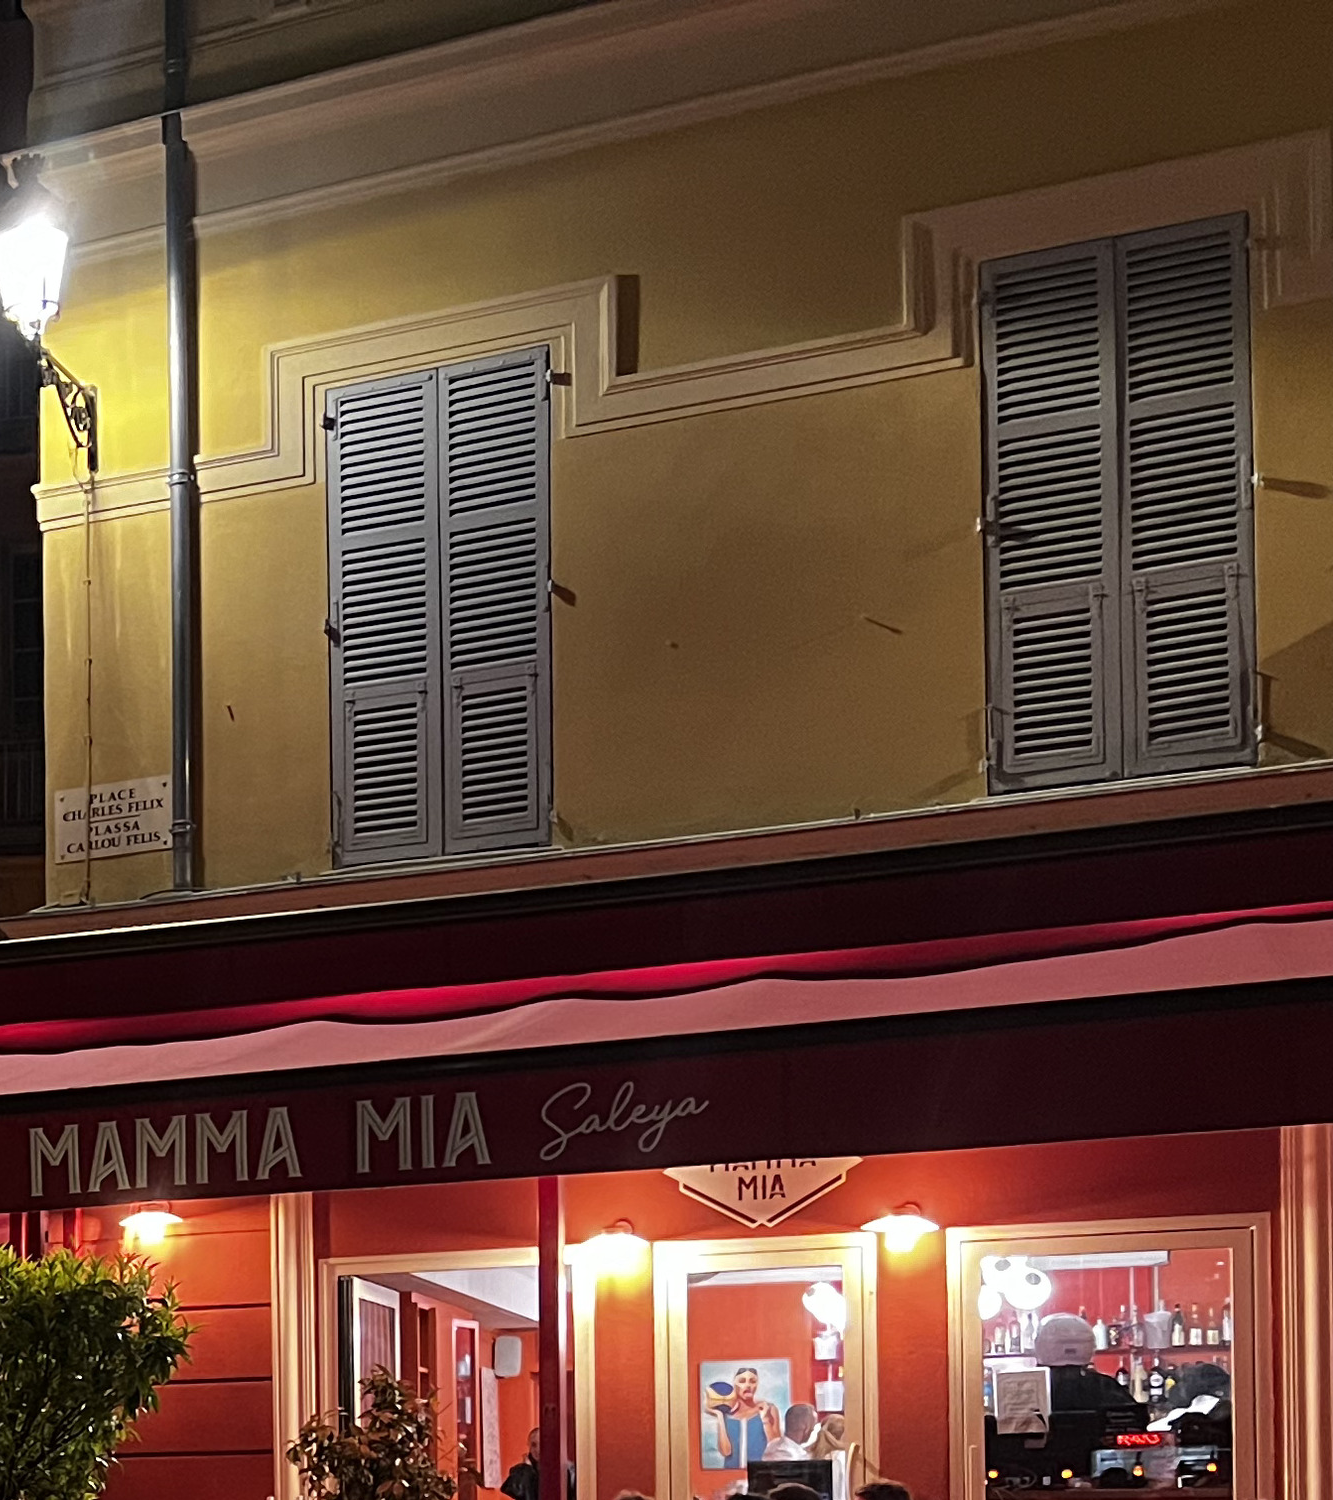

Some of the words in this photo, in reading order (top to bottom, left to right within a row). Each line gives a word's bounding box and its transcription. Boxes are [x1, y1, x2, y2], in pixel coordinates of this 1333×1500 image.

[89, 788, 136, 804] PLACE
[128, 798, 164, 813] FELIX
[126, 831, 161, 846] FELIS
[29, 1106, 303, 1197] MAMMA
[355, 1091, 491, 1173] MIA
[539, 1081, 709, 1161] Saleya
[737, 1174, 786, 1201] MIA
